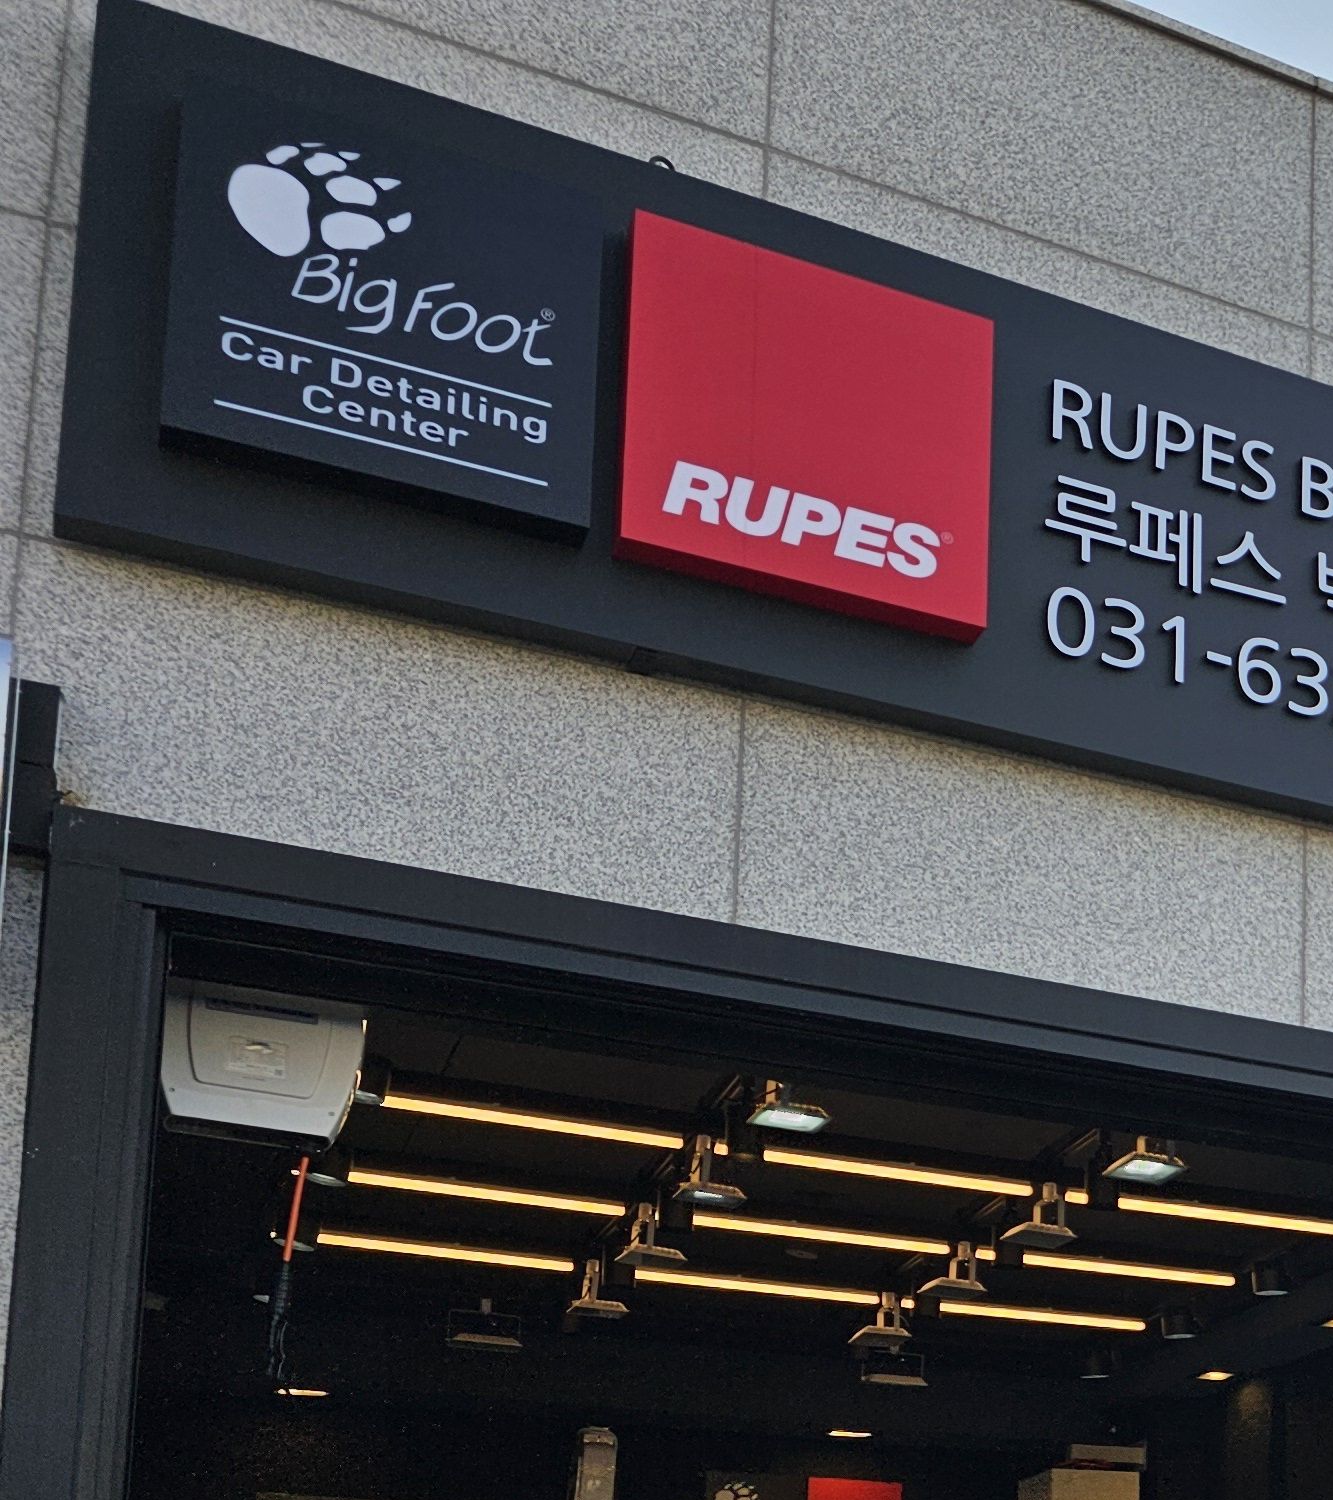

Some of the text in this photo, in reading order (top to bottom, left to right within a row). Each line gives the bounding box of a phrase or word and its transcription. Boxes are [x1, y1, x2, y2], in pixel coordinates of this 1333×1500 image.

[219, 330, 549, 446] Car Detailing
[301, 384, 469, 448] Center
[1051, 378, 1277, 501] RUPES
[661, 460, 941, 579] RUPES
[1045, 473, 1287, 605] 루페스
